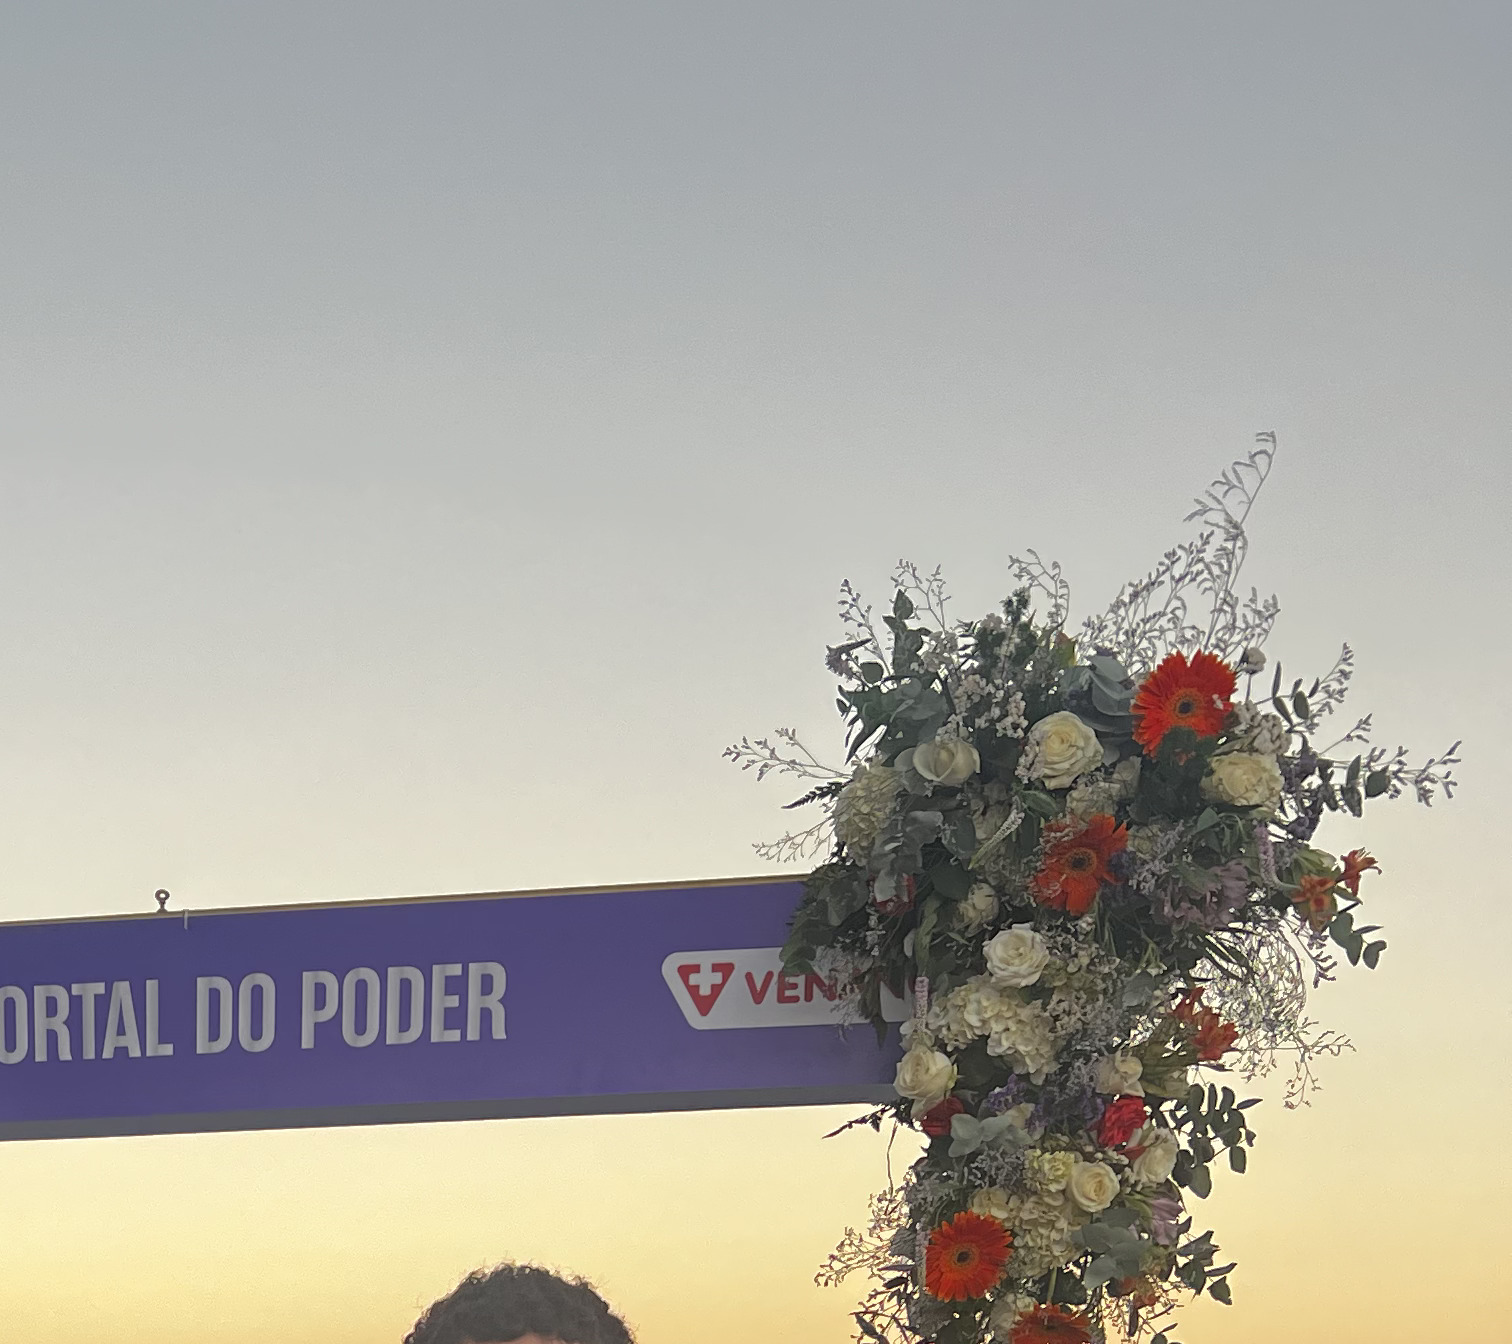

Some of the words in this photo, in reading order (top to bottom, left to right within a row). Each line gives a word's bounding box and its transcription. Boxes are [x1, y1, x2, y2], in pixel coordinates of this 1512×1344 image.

[196, 972, 276, 1054] DO
[301, 961, 507, 1049] PODER
[744, 969, 845, 1005] VEN
